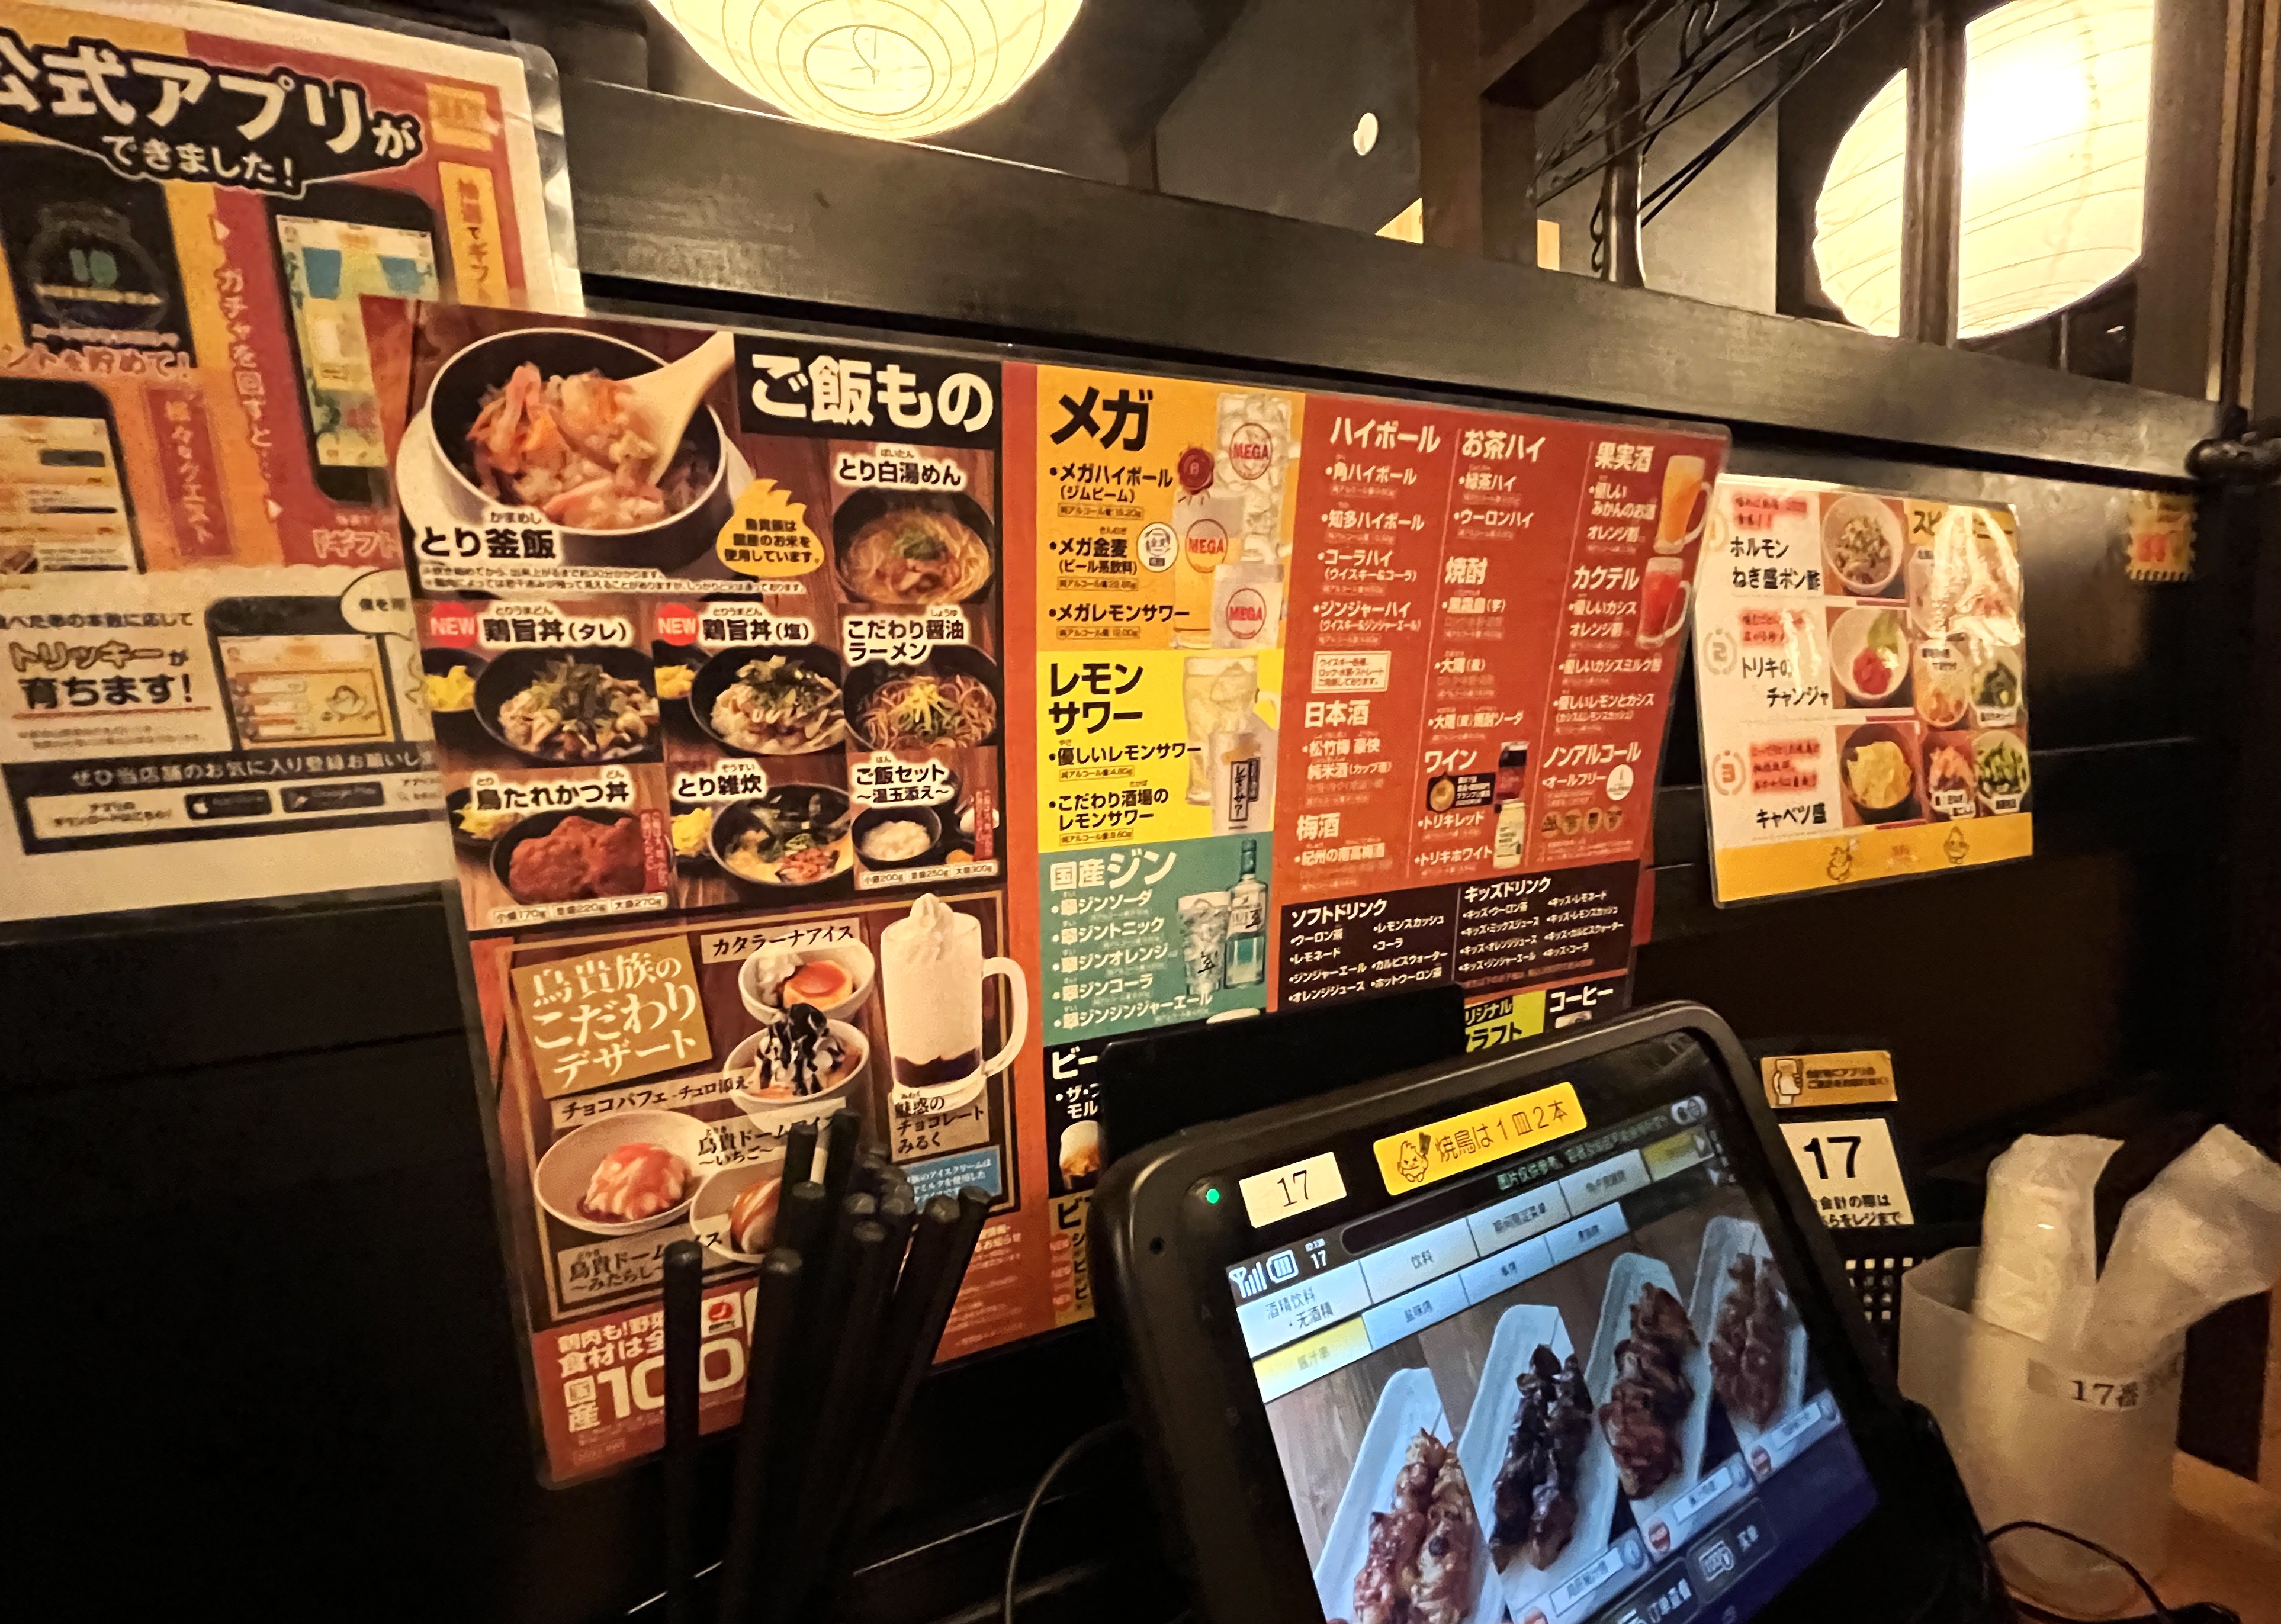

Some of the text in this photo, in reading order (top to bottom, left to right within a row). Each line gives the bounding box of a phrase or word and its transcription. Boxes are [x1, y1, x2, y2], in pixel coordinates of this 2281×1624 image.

[0, 36, 417, 158] 公式アプリが
[102, 134, 294, 186] できました!
[752, 354, 994, 433] ご飯もの
[1050, 386, 1153, 451] メガ
[1330, 417, 1441, 454] ハイボール
[1461, 429, 1546, 463] お茶ハイ
[1233, 444, 1268, 460] MEGA
[1595, 442, 1654, 473] 果実酒
[838, 458, 962, 487] とり白湯めん
[1060, 464, 1173, 488] メガハイボール
[1334, 462, 1418, 485] 角ハイボール
[1060, 488, 1135, 503] (ジムビーム)
[1328, 509, 1425, 531] 知多ハイボール
[1460, 510, 1534, 529] ウーロンハイ
[420, 526, 556, 559] とり釜飯
[1059, 538, 1127, 558] メガ金麦
[1188, 539, 1223, 554] MEGA
[1730, 536, 1790, 559] ホルモン
[1325, 549, 1393, 568] コーラハイ
[1445, 556, 1488, 586] 焼酎
[1572, 565, 1640, 590] カクテル
[1056, 604, 1190, 622] メガレモンサワー
[1229, 607, 1263, 621] MEGA
[1321, 602, 1411, 618] ジンジャーハイ
[431, 616, 475, 635] NEW
[657, 617, 696, 635] NEW
[847, 619, 965, 641] こだわり醤油
[9, 639, 189, 672] トリッキーが
[848, 641, 928, 662] ラーメン
[18, 674, 194, 709] 育ちます!
[1050, 663, 1143, 697] レモン
[1766, 686, 1829, 707] チャンジャ
[1049, 701, 1143, 735] サワー
[1304, 699, 1371, 729] 日本酒
[1057, 742, 1201, 766] 優しいレモンサワー
[1425, 748, 1478, 774] ワイン
[1543, 741, 1641, 768] ノンアルコール
[678, 773, 762, 798] とり雑炊
[856, 763, 946, 786] ご飯セット
[1546, 774, 1607, 789] オールフリー
[477, 781, 629, 810] 鳥たれかつ丼
[1058, 788, 1168, 811] こだわり酒場の
[1059, 809, 1154, 831] レモンサワー
[1296, 812, 1341, 841] 梅酒
[1424, 810, 1485, 830] トリキレッド
[1756, 802, 1826, 829] キャベツ盛
[1421, 845, 1492, 866] トリキホワイト
[1050, 848, 1177, 892] 国産ジン
[1464, 876, 1551, 903] キッズドリンク
[1292, 898, 1387, 928] ソフトドリンク
[1377, 915, 1444, 934] レモンスカッシュ
[713, 924, 854, 957] カタラーナアイス
[1294, 928, 1343, 946] ウーロン茶
[1377, 938, 1403, 951] コーラ
[1294, 947, 1341, 964] レモネード
[1376, 951, 1448, 970] カルピスウォーター
[532, 951, 682, 1008] 鳥貴族の
[1294, 963, 1367, 984] ジンジャーエール
[1376, 967, 1442, 988] ホットウーロン茶
[1293, 981, 1365, 1002] オレンジジュース
[1550, 985, 1614, 1012] コーヒー
[532, 981, 697, 1049] こだわり
[554, 1029, 696, 1089] デザート
[897, 1106, 983, 1136] チョコレート
[898, 1132, 940, 1153] みるく
[1803, 1136, 1861, 1179] 17
[1277, 1169, 1309, 1207] 17
[1310, 1250, 1327, 1270] 17
